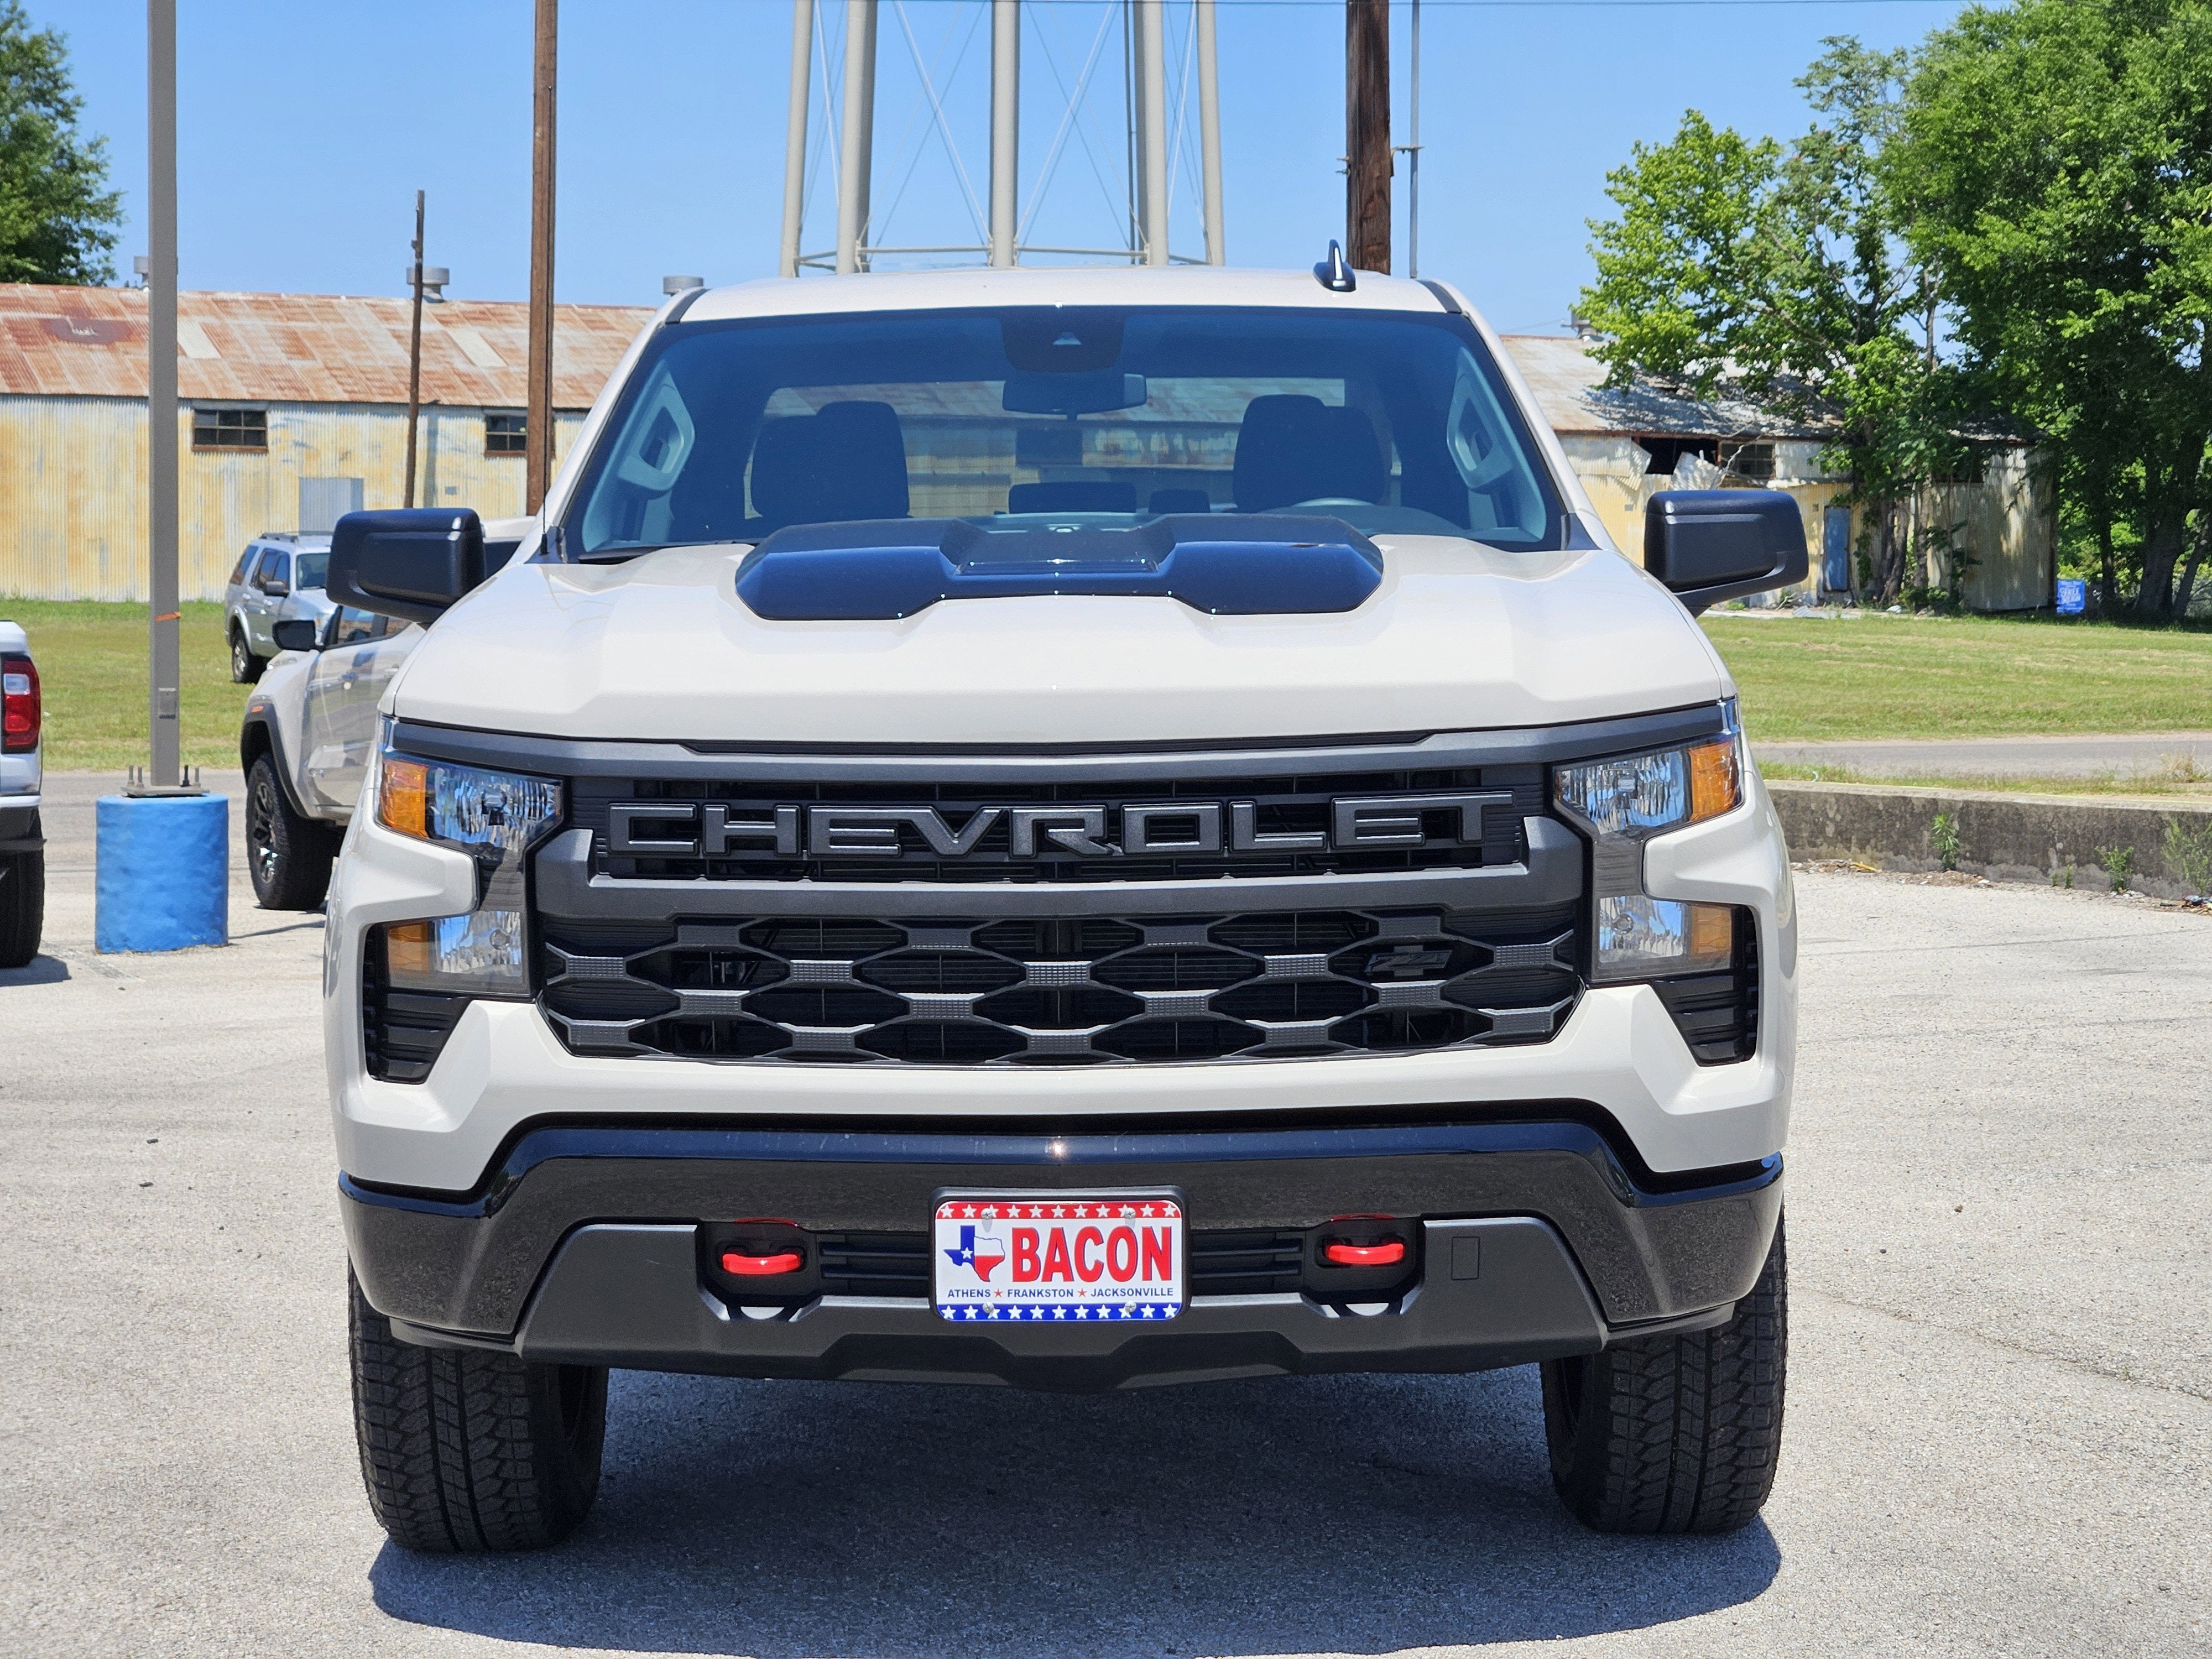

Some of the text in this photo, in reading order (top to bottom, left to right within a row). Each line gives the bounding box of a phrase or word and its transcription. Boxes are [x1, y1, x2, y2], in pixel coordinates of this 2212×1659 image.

[609, 791, 1514, 858] CHEVROLET
[1012, 1226, 1172, 1282] BACON
[947, 1288, 1173, 1298] ATHENS FRANKSTON JACKSONVILLE
